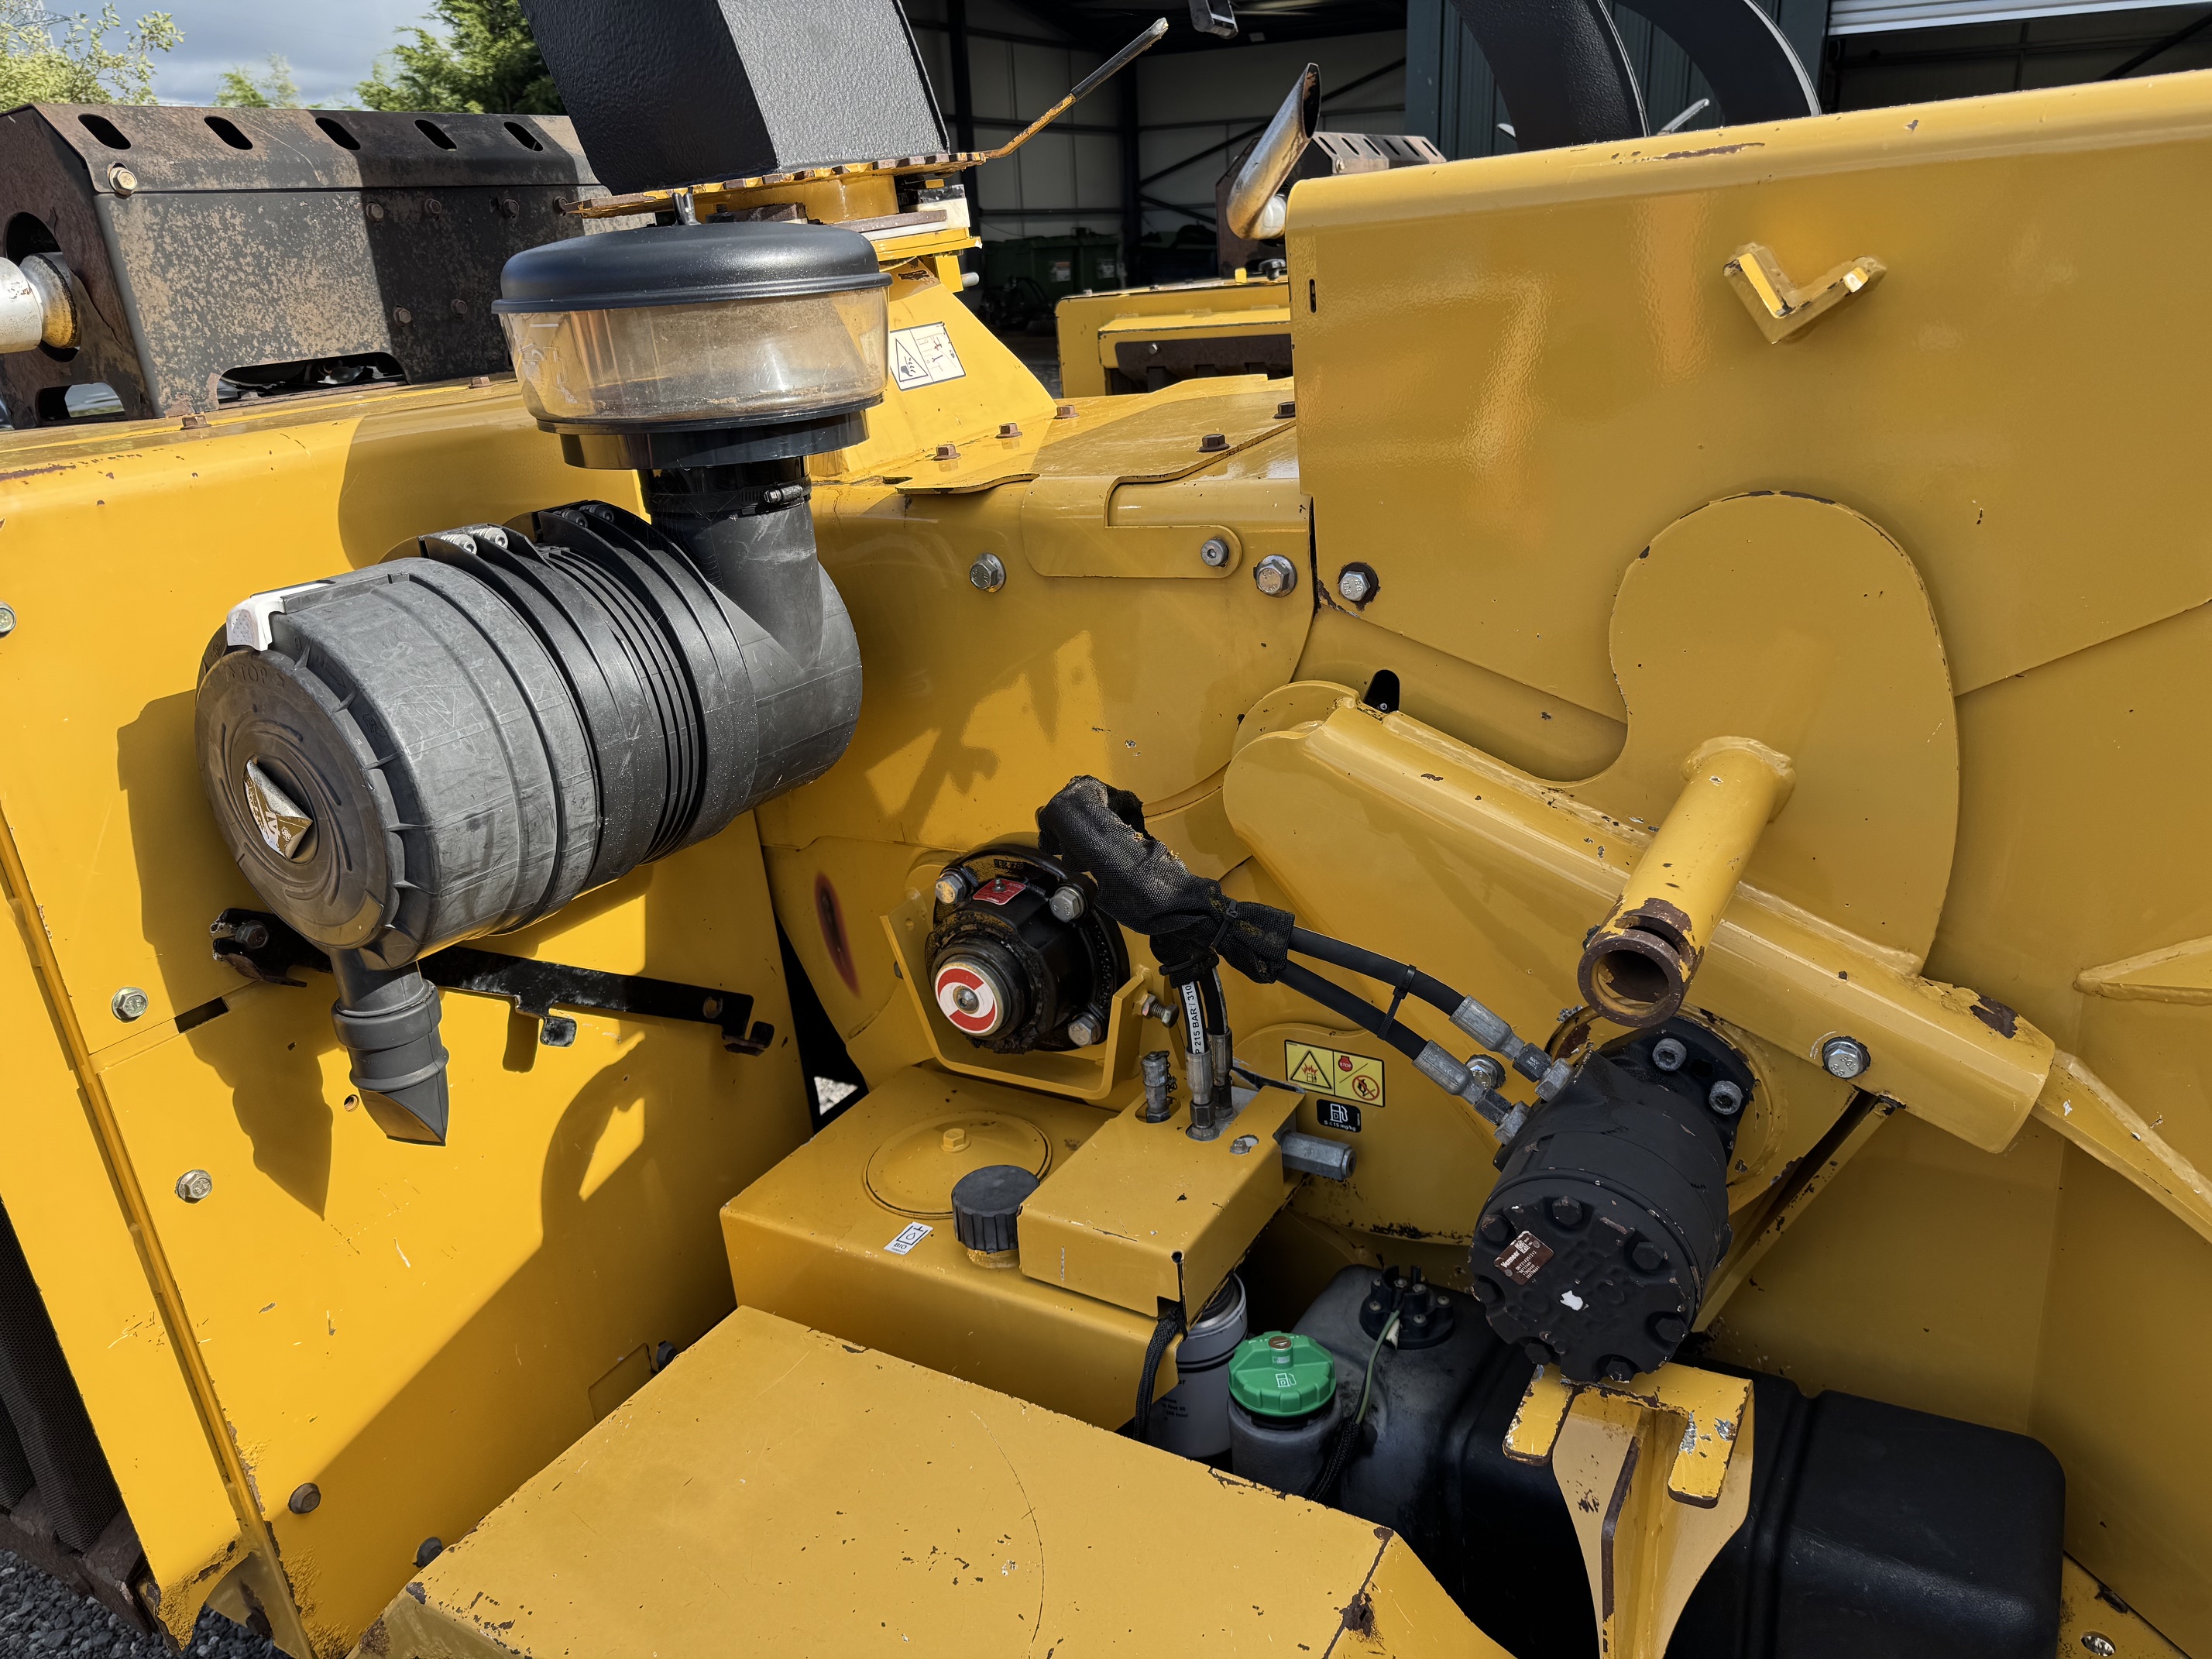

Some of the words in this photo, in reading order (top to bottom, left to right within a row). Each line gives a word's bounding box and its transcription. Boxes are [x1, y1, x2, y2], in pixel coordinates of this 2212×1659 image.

[239, 664, 267, 684] TOP
[1190, 1008, 1199, 1028] BAR
[1500, 1249, 1520, 1268] Vermeer
